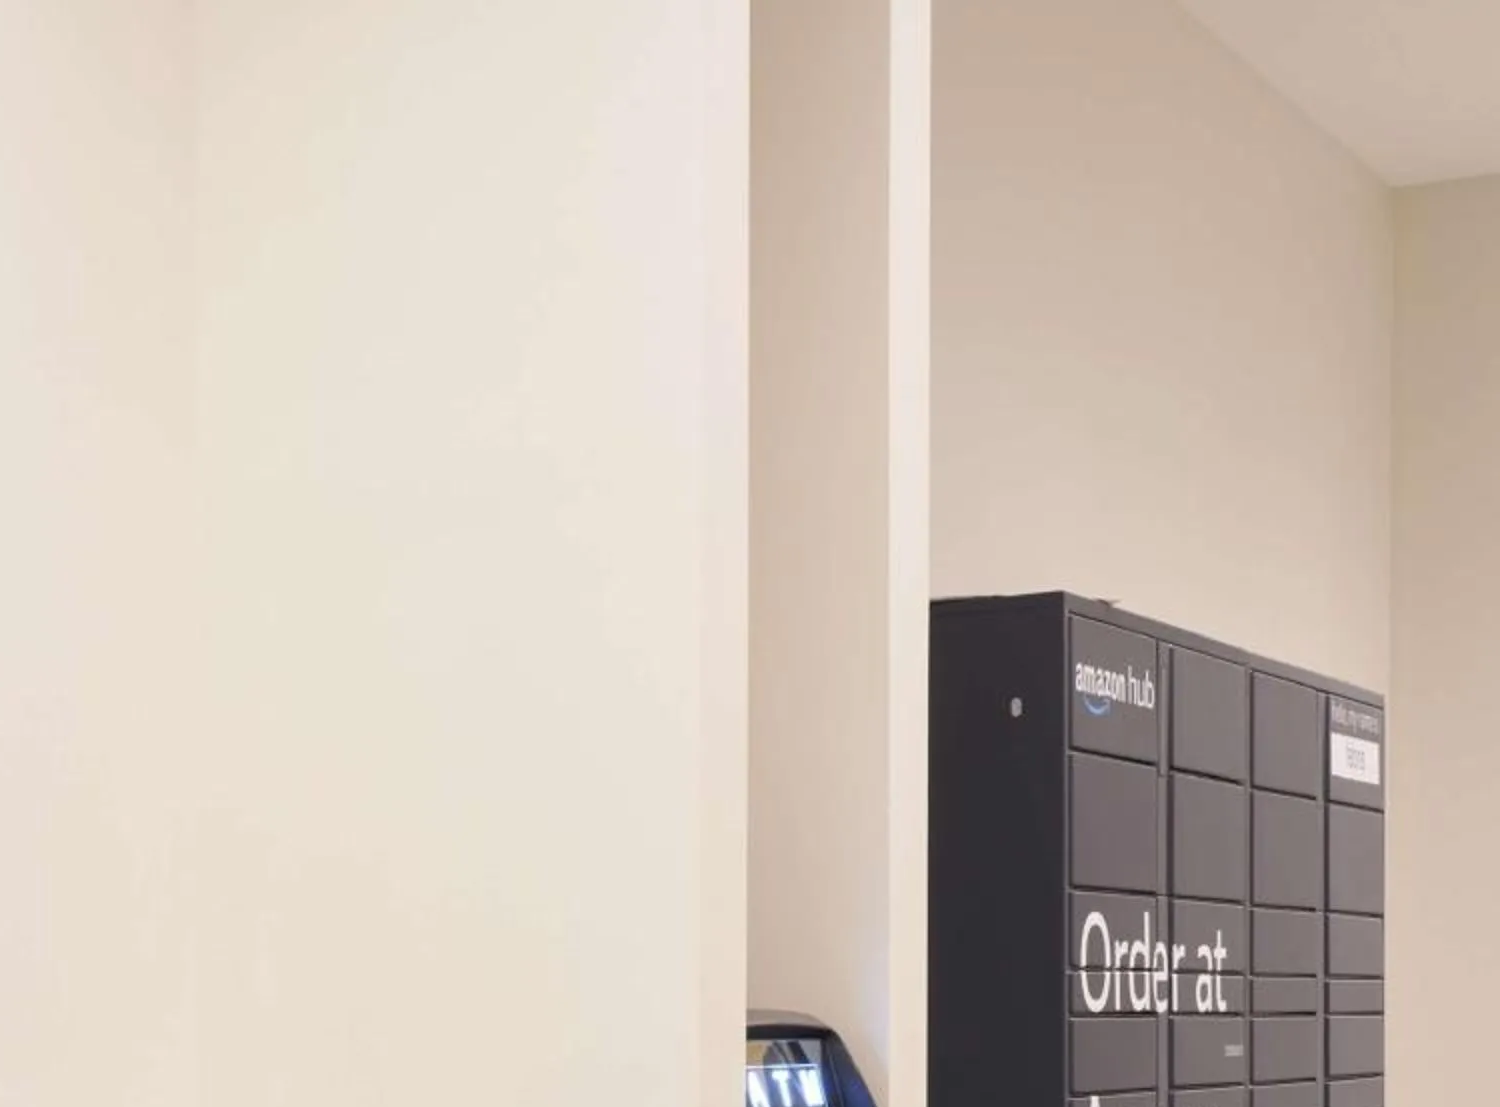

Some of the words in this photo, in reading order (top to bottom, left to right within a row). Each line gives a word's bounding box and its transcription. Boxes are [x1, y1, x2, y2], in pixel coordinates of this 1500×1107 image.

[1075, 662, 1126, 702] amazon
[1127, 665, 1155, 709] hub
[1080, 911, 1185, 1013] Order
[1195, 929, 1227, 1013] at
